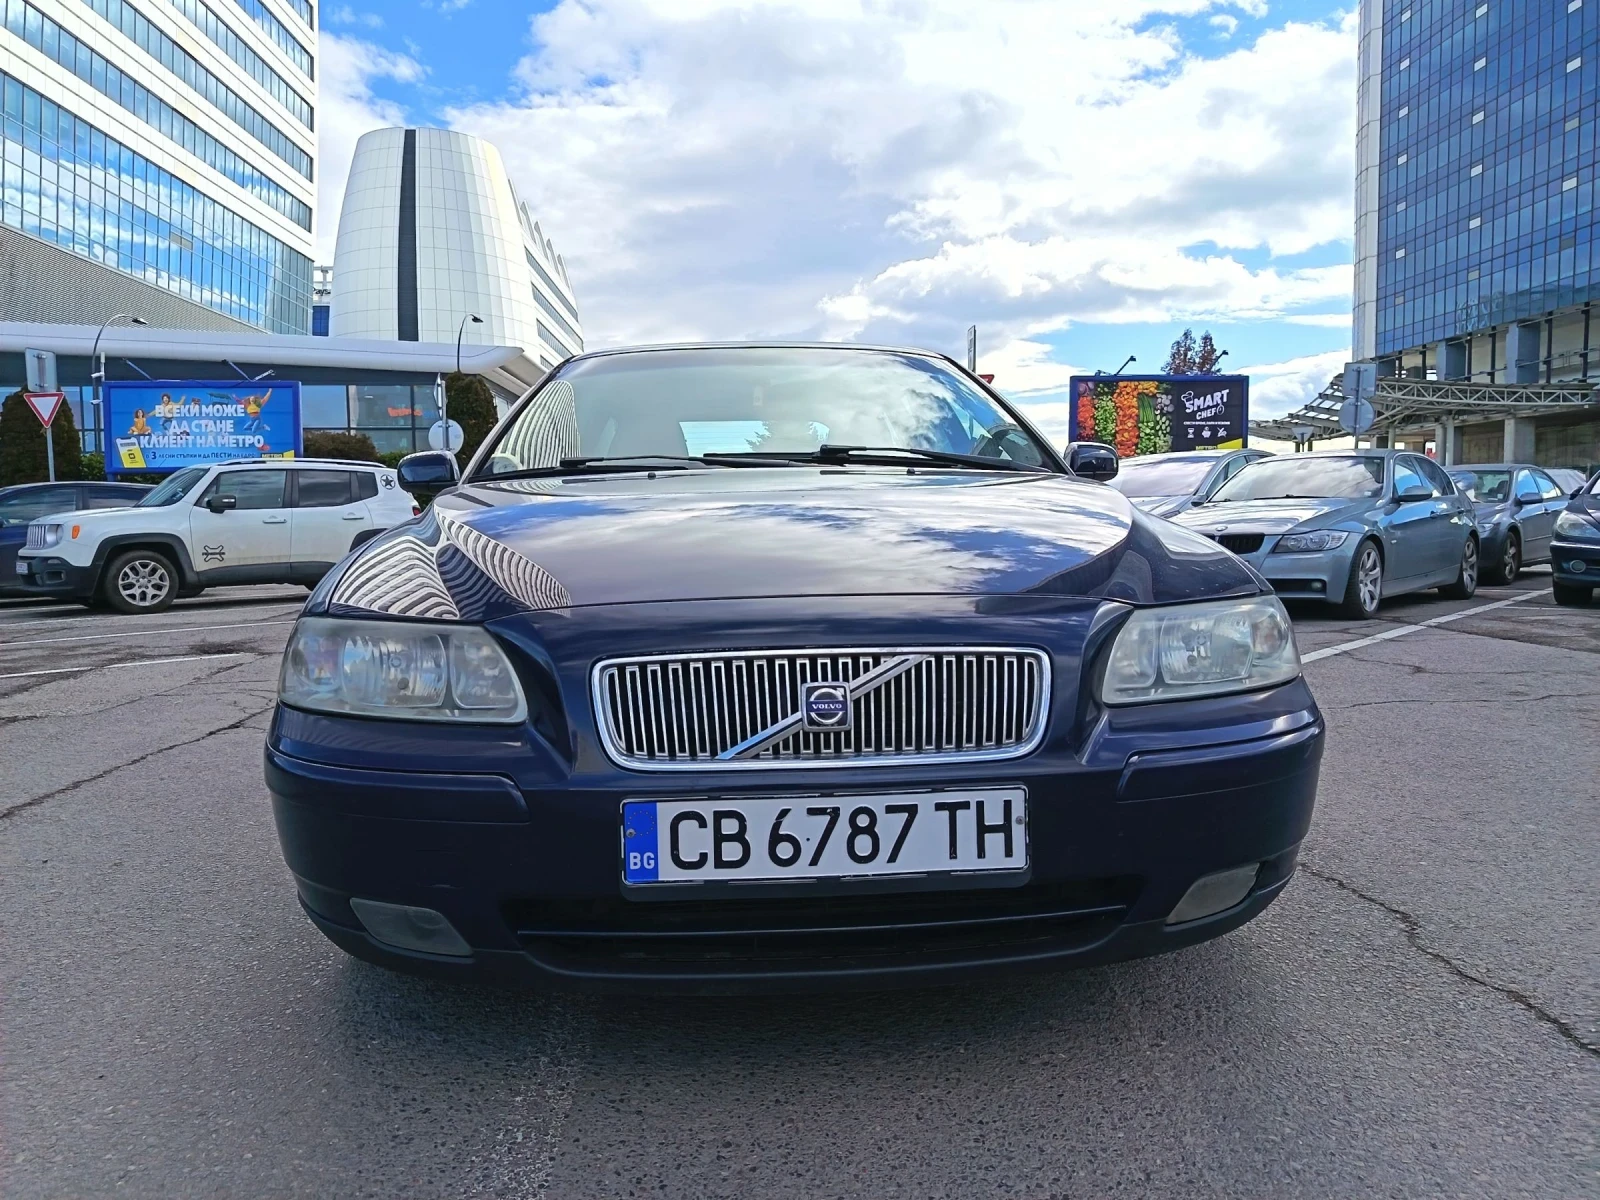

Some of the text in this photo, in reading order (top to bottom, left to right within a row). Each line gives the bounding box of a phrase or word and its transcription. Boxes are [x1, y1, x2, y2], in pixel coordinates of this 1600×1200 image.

[1185, 389, 1229, 413] SMART
[155, 404, 245, 417] ВСЕКИ МОЖЕ
[1196, 407, 1216, 420] CHEF
[169, 420, 234, 434] ДА СТАНЕ
[140, 435, 264, 448] КЛИЕНТ НА МЕТРО
[151, 451, 157, 460] 3
[669, 799, 1013, 870] CB 6787 TH
[629, 851, 655, 870] BG
